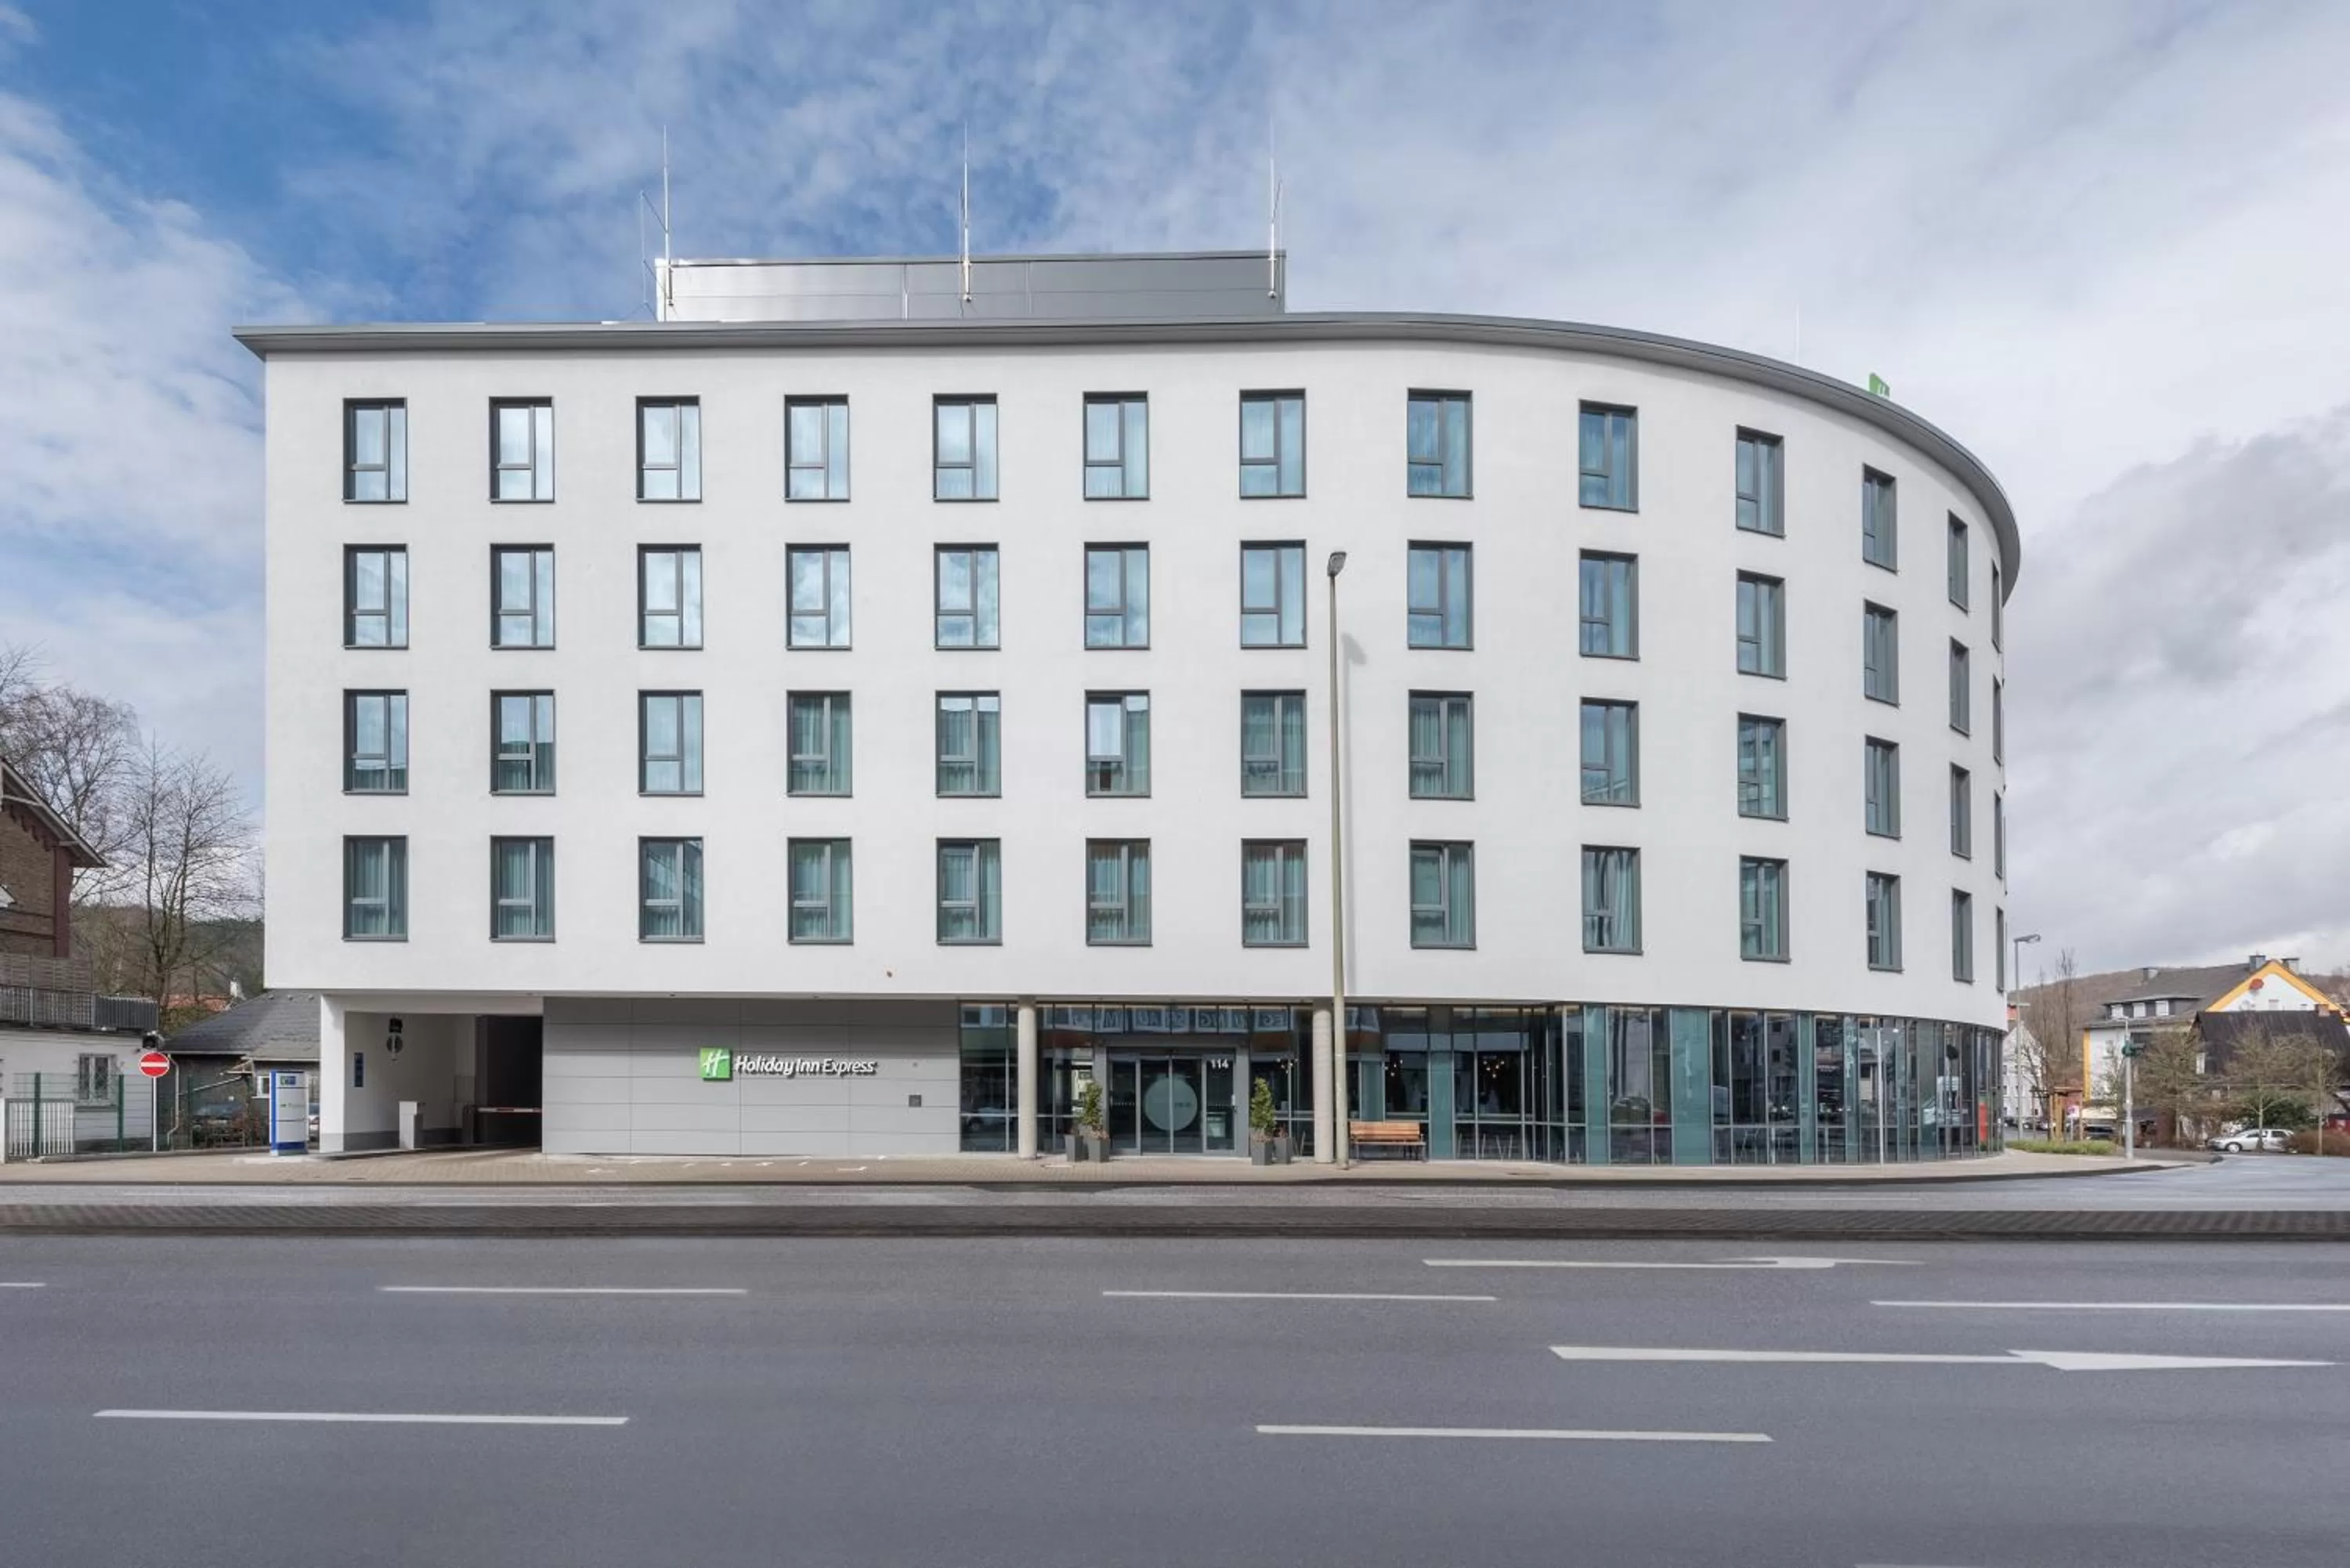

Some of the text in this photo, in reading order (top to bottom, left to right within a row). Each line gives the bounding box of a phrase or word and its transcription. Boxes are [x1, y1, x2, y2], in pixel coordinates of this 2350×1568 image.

[736, 1055, 876, 1075] Holiday Inn Express
[1210, 1058, 1229, 1069] 114
